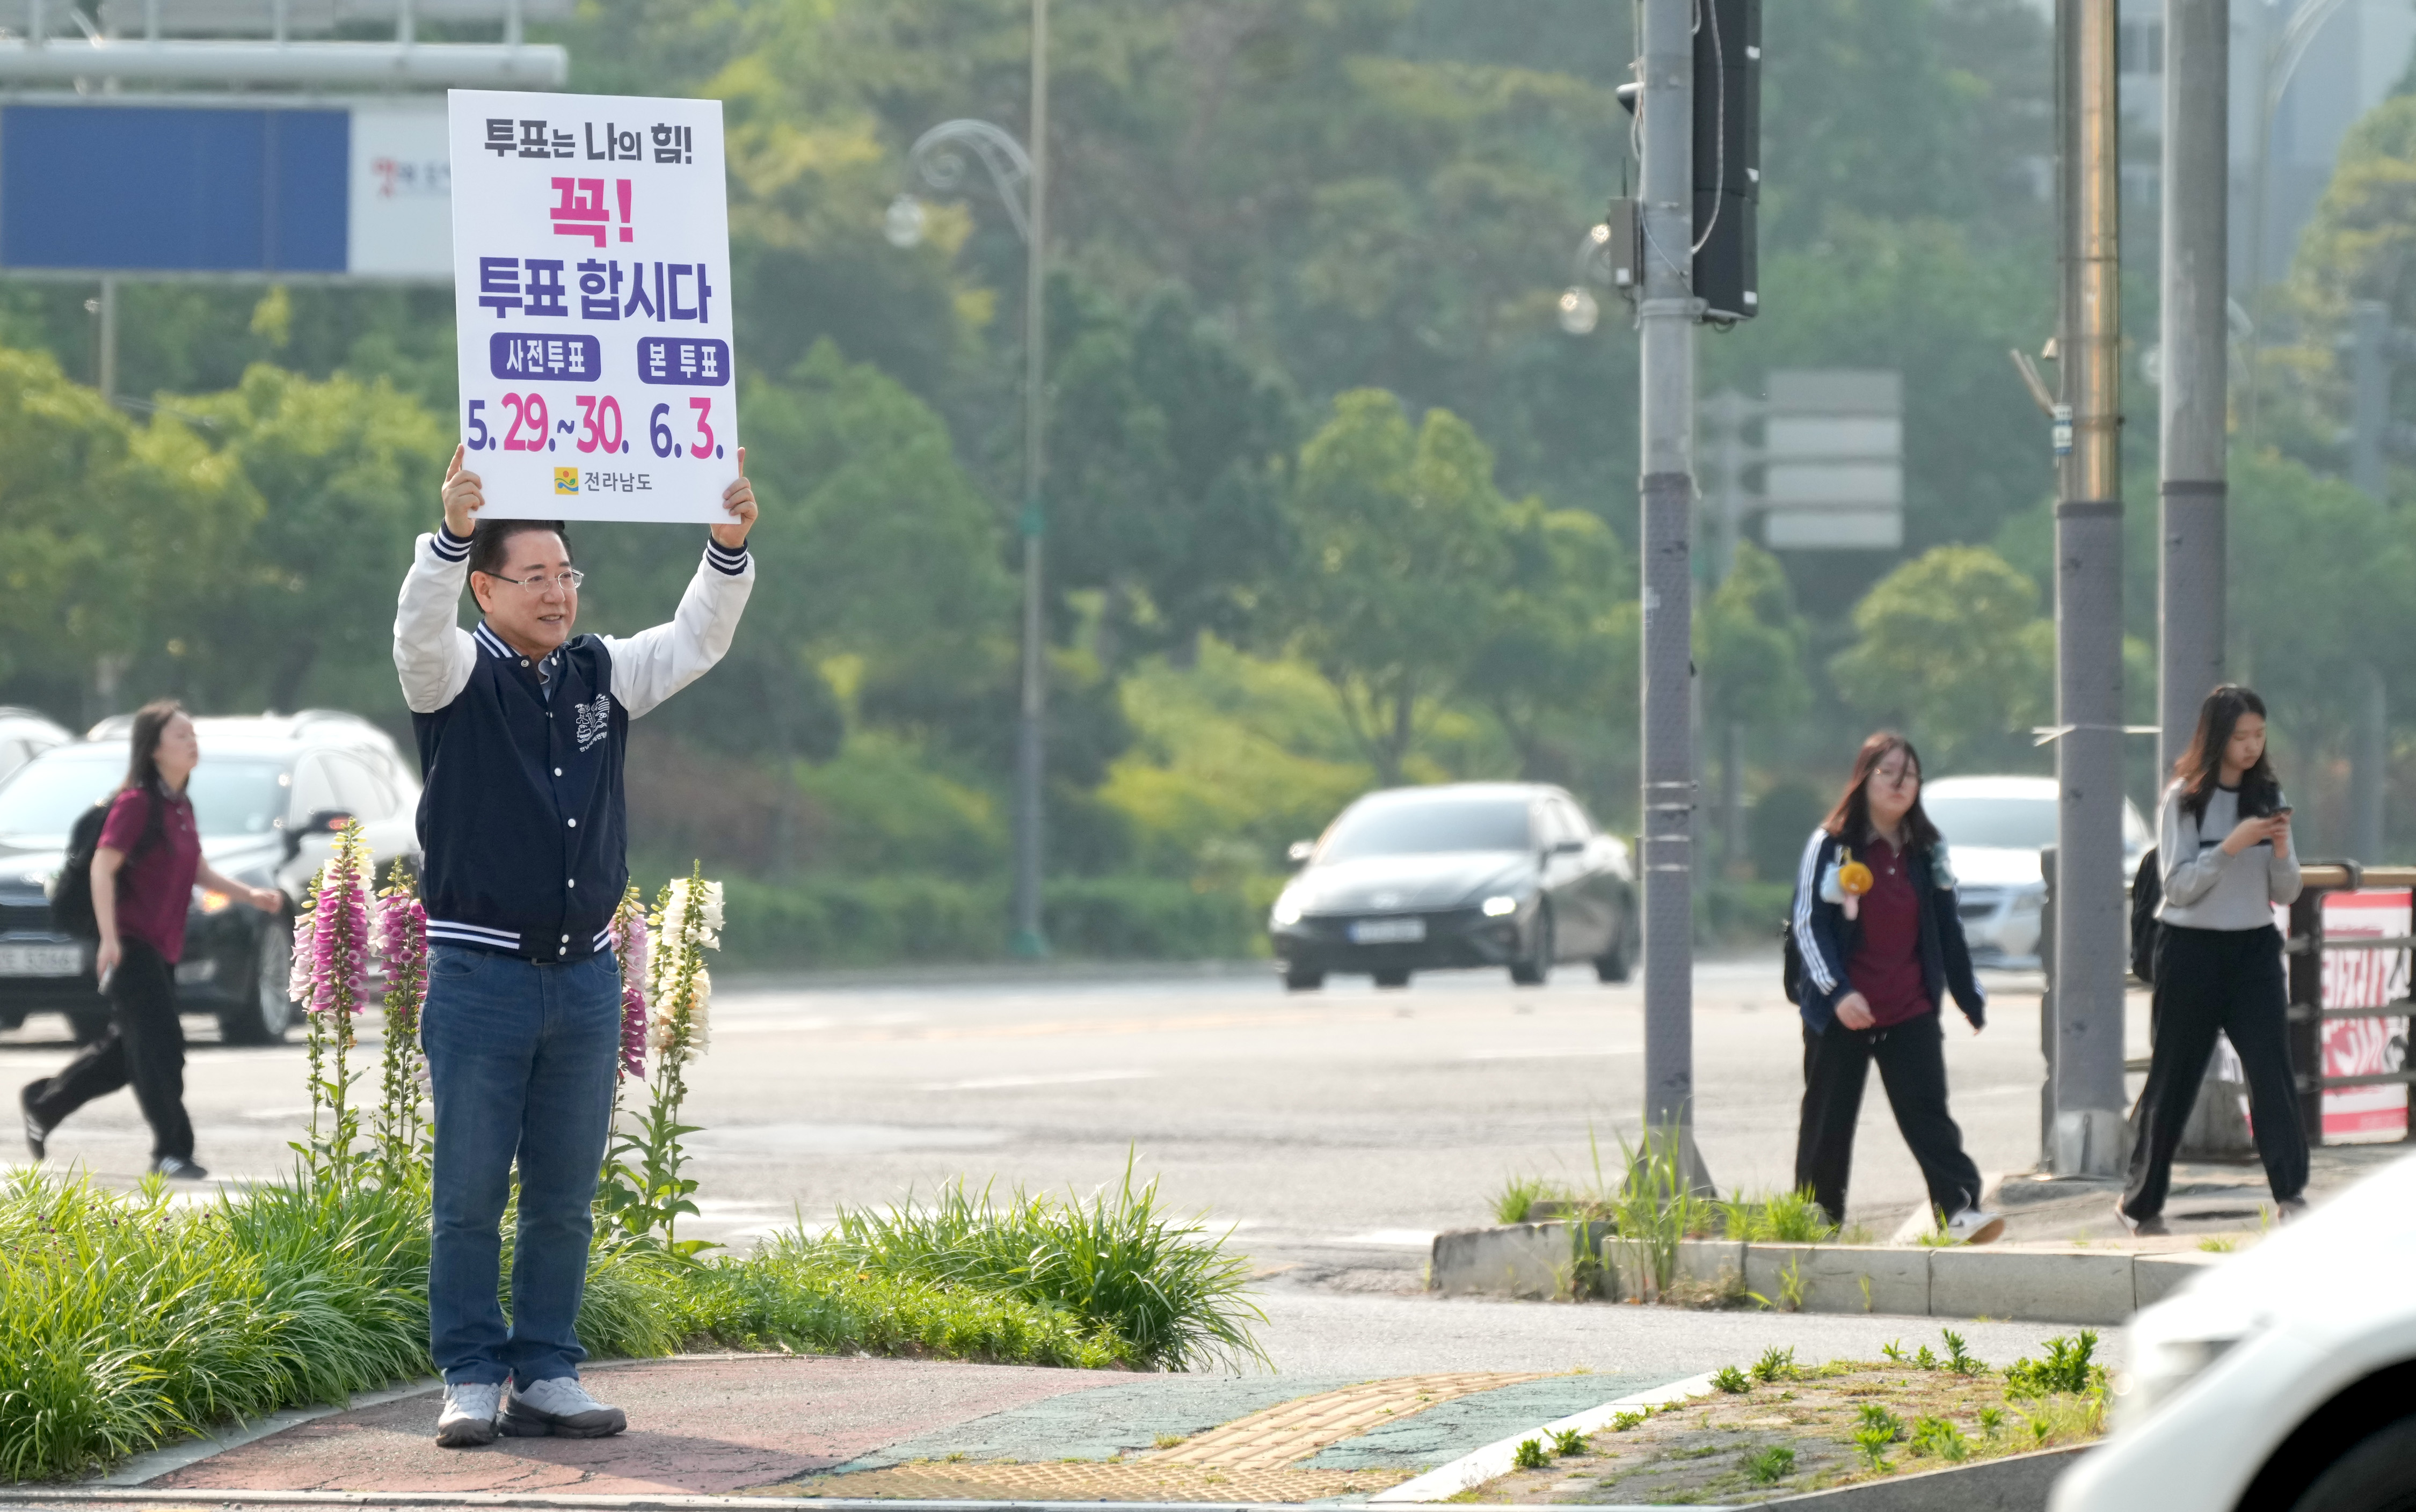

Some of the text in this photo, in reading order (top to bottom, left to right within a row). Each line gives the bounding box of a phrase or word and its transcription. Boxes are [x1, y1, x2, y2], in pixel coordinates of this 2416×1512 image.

[485, 118, 692, 165] 투표는 나의 힘!
[550, 177, 634, 248] 꼭!
[479, 257, 712, 324] 투표 합시다
[506, 339, 586, 374] 사전투표
[649, 343, 718, 378] 본 투표
[584, 472, 652, 492] 전라남도
